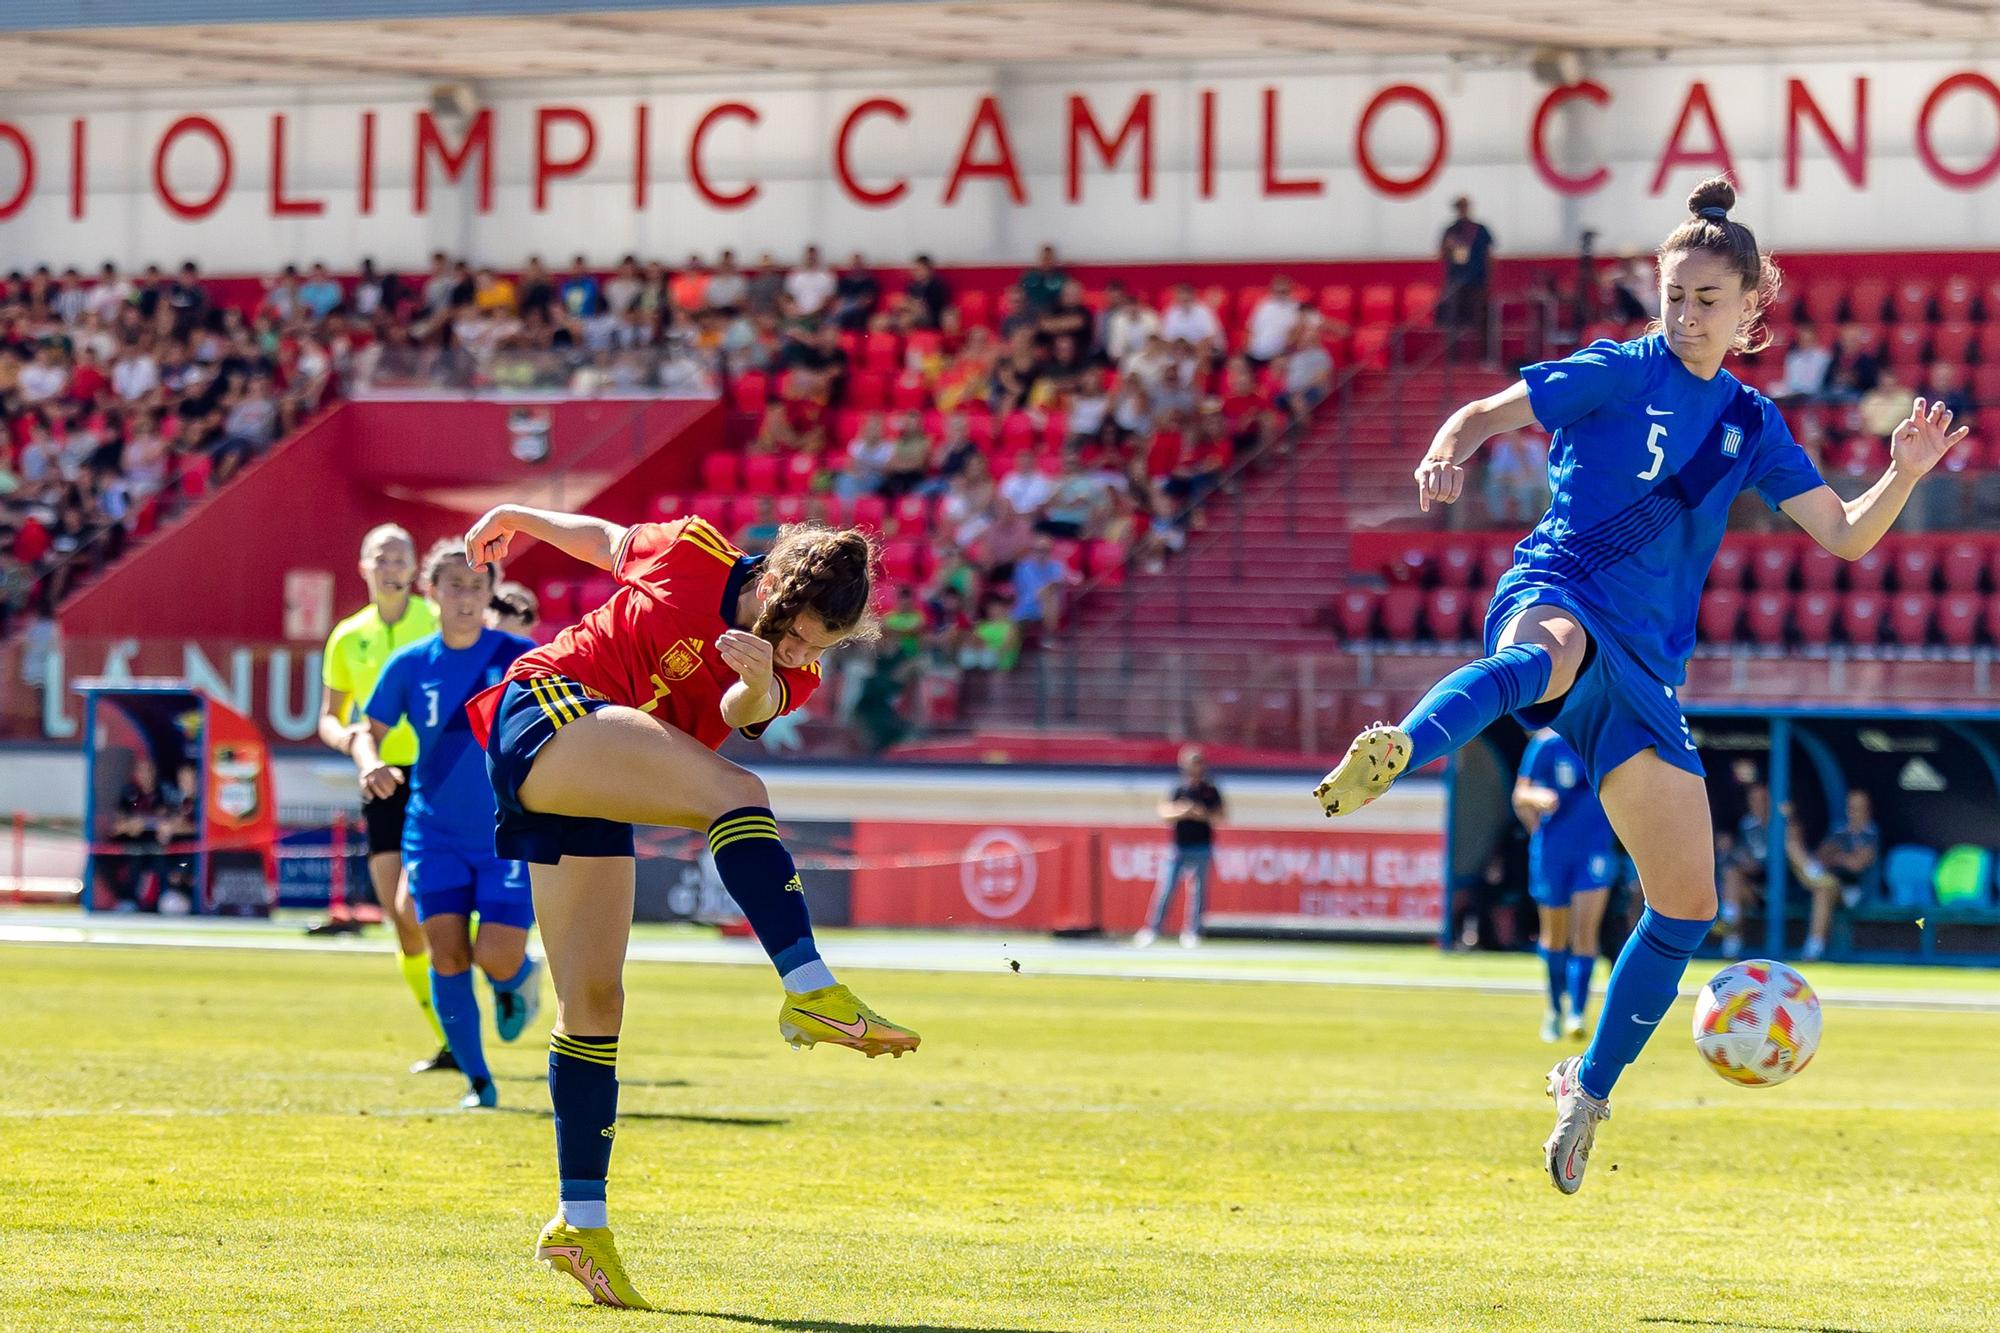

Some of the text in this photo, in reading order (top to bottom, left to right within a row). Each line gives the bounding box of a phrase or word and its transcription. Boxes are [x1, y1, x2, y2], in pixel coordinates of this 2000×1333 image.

[151, 99, 761, 222] OLIMPIC
[832, 82, 1450, 209] CAMILO
[1527, 70, 2000, 195] CANO
[1636, 422, 1669, 481] 5
[424, 689, 440, 728] 3
[1212, 844, 1367, 886] WOMAN
